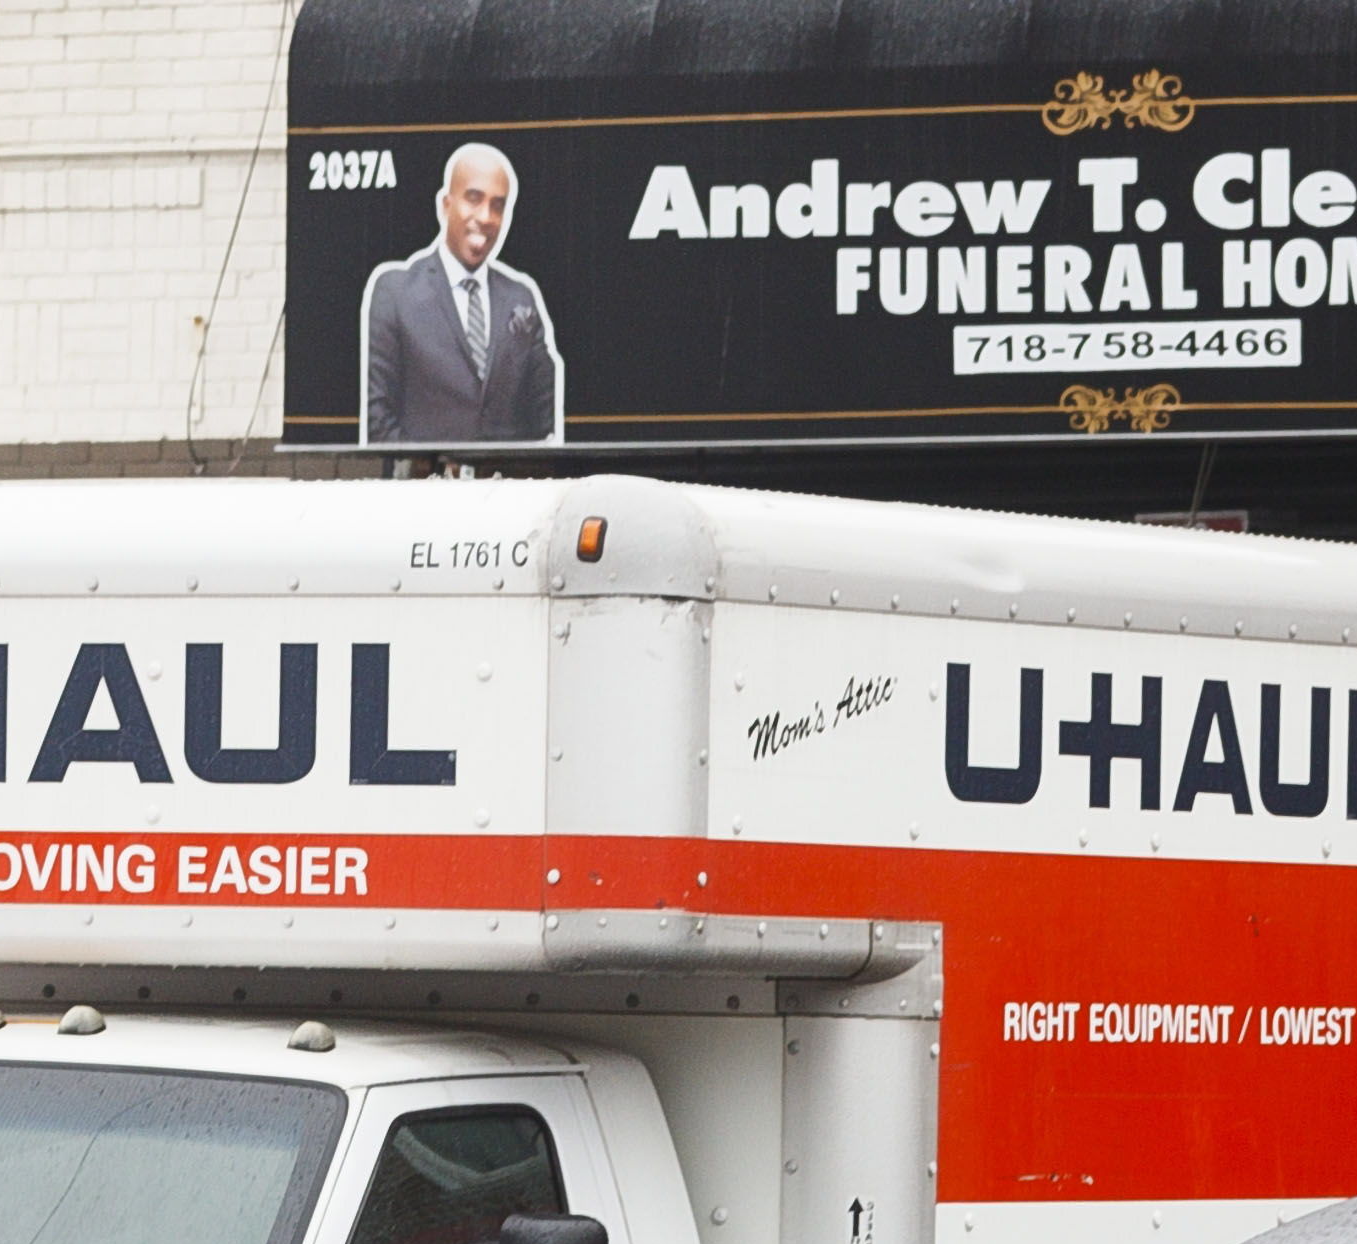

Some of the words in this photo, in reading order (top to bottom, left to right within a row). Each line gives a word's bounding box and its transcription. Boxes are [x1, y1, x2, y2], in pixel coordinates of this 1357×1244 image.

[309, 150, 397, 192] 2037A
[629, 159, 1052, 240] Andrew
[1078, 157, 1167, 232] T.
[835, 242, 1198, 314] FUNERAL
[967, 328, 1289, 365] 718-758-4466
[410, 542, 440, 568] EL
[449, 541, 501, 568] 1761
[511, 540, 530, 568] C
[748, 700, 825, 762] Mom's
[833, 675, 894, 728] Attic
[177, 843, 370, 898] EASIER
[1004, 1002, 1080, 1044] RIGHT
[1089, 1003, 1235, 1045] EQUIPMENT
[1259, 1006, 1355, 1046] LOWEST
